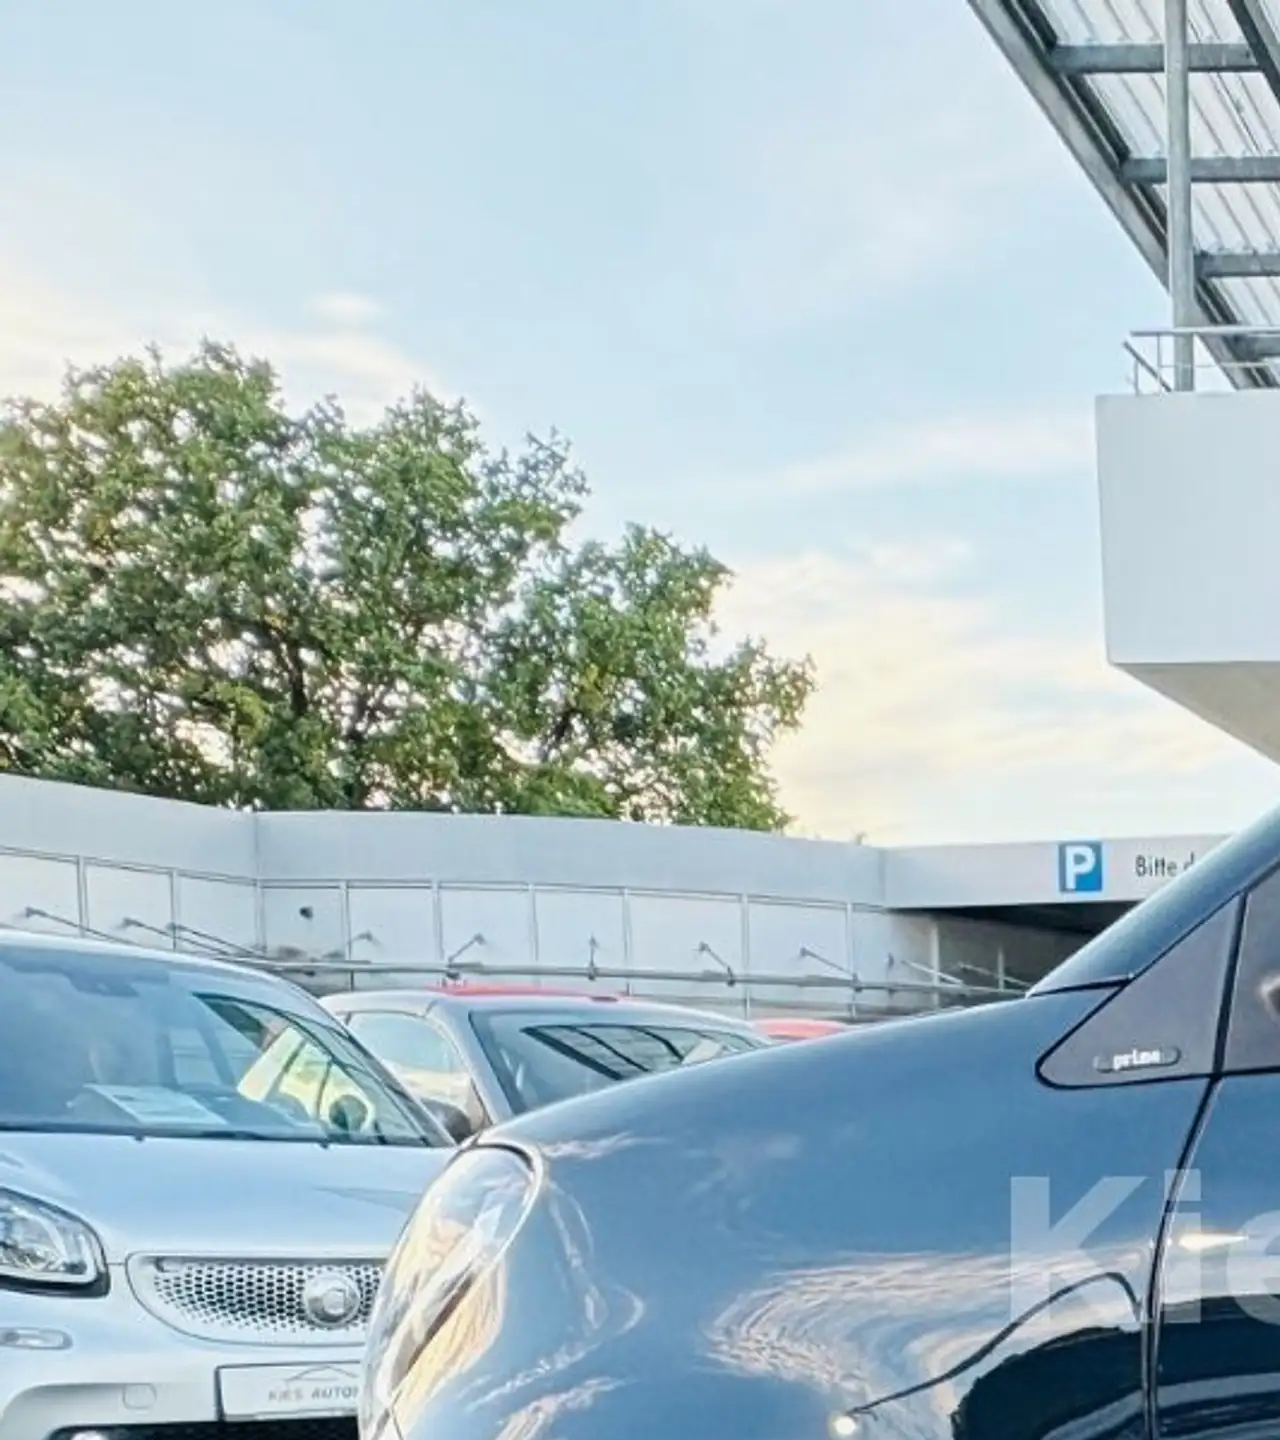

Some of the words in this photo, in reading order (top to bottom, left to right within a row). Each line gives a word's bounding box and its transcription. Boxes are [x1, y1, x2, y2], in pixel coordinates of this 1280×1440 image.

[1065, 845, 1096, 889] P
[1134, 854, 1178, 878] Bitte
[1112, 1048, 1161, 1071] prime
